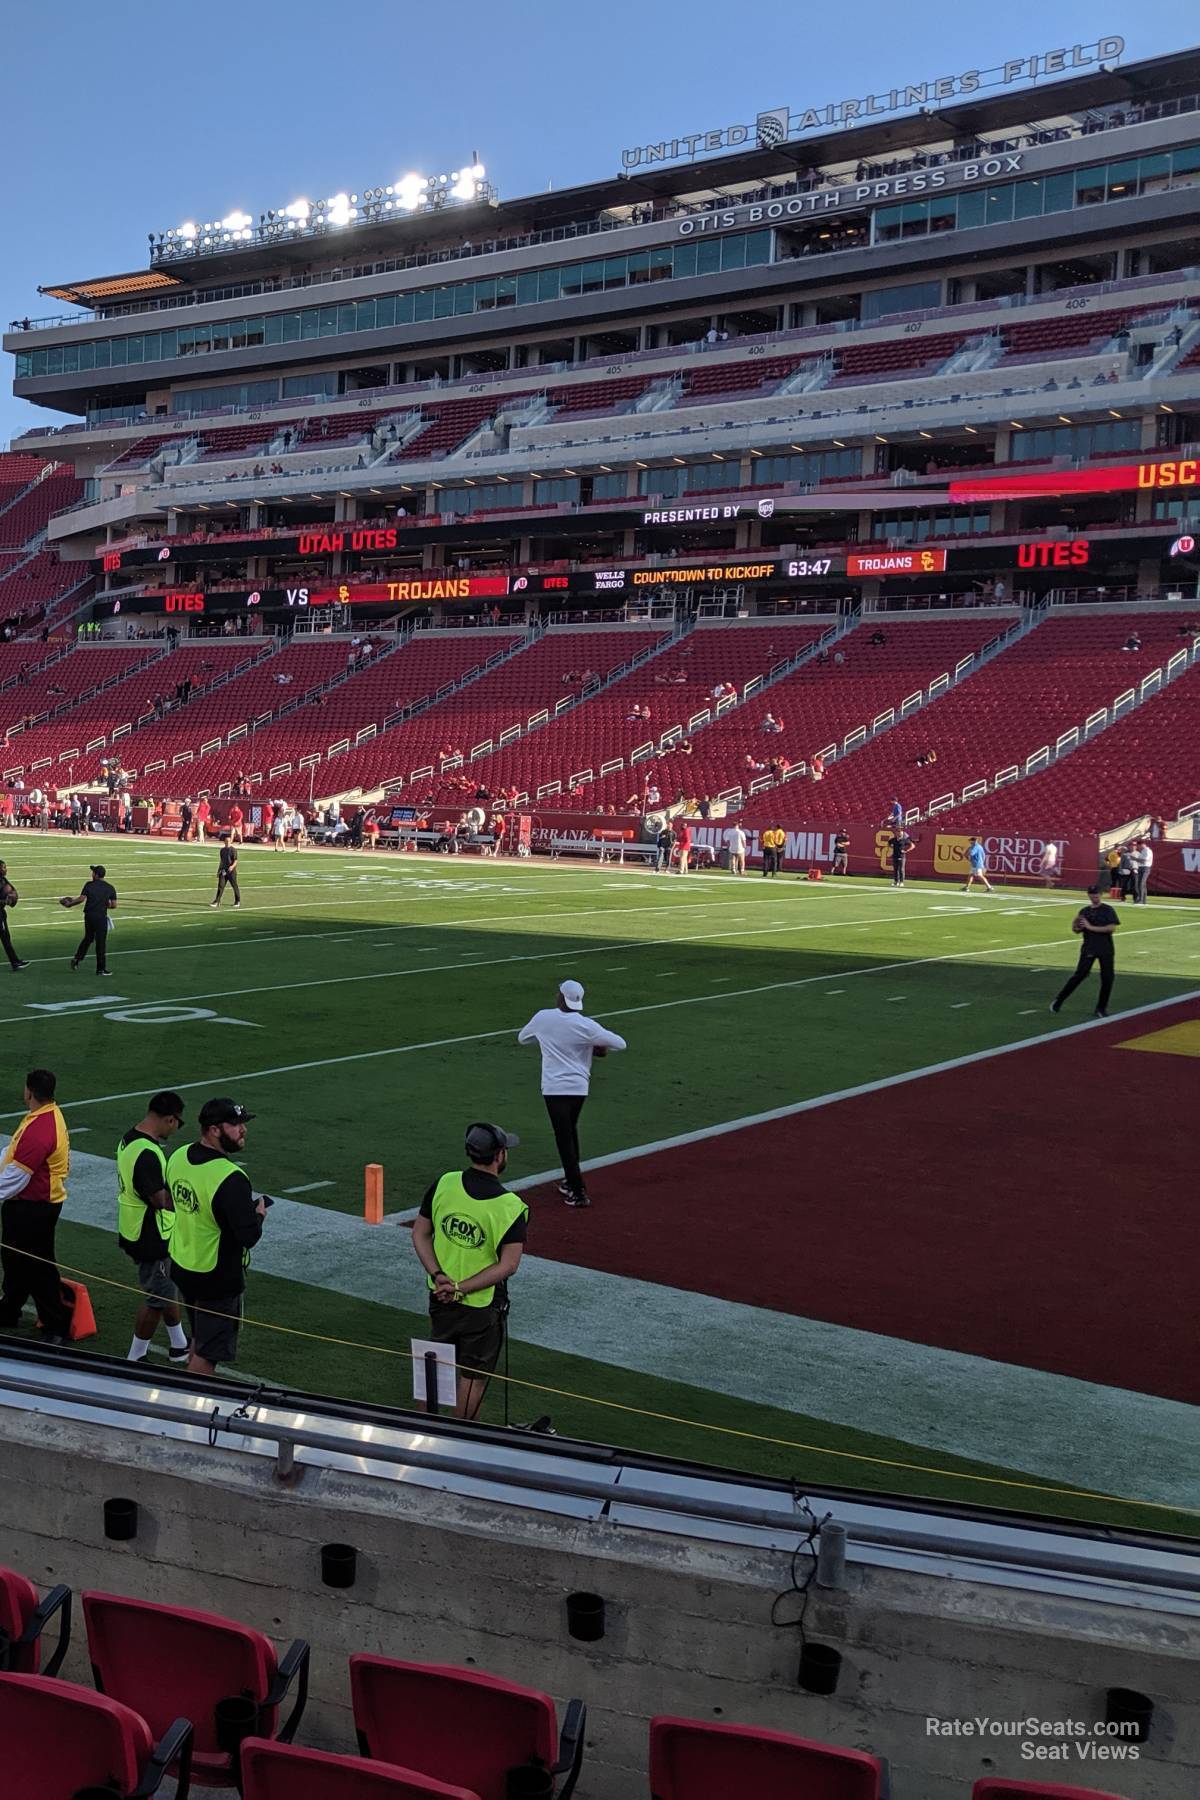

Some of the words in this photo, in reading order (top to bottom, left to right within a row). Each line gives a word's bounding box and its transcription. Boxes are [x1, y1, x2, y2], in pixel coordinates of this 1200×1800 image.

[622, 125, 748, 168] UNITED
[799, 71, 980, 129] AIRLINES
[1004, 36, 1125, 84] FIELD
[679, 211, 736, 235] OTIS
[749, 193, 841, 223] BOOTH
[856, 170, 946, 201] PRESS
[963, 153, 1024, 182] BOX
[904, 323, 923, 333] 407
[748, 345, 765, 355] 406
[606, 366, 622, 375] 405
[1138, 461, 1197, 488] USC
[643, 509, 719, 524] PRESENTED
[723, 505, 741, 518] BY
[299, 533, 344, 554] UTAH
[351, 529, 398, 551] UTES
[103, 553, 122, 572] UTES
[857, 557, 913, 570] TROJANS
[1017, 540, 1089, 568] UTES
[595, 570, 625, 580] WELLS
[633, 569, 706, 585] COUNTDOWN
[706, 567, 723, 580] TO
[725, 564, 775, 580] KICKOFF
[788, 560, 831, 576] 63:47
[387, 579, 471, 601] TROJANS
[543, 577, 569, 589] UTES
[595, 580, 625, 589] FARGO
[165, 593, 205, 612] UTES
[286, 588, 309, 606] VS
[531, 828, 597, 841] ERRANEA
[937, 844, 969, 862] US
[984, 836, 1070, 857] CREDT
[450, 1217, 477, 1238] FOX
